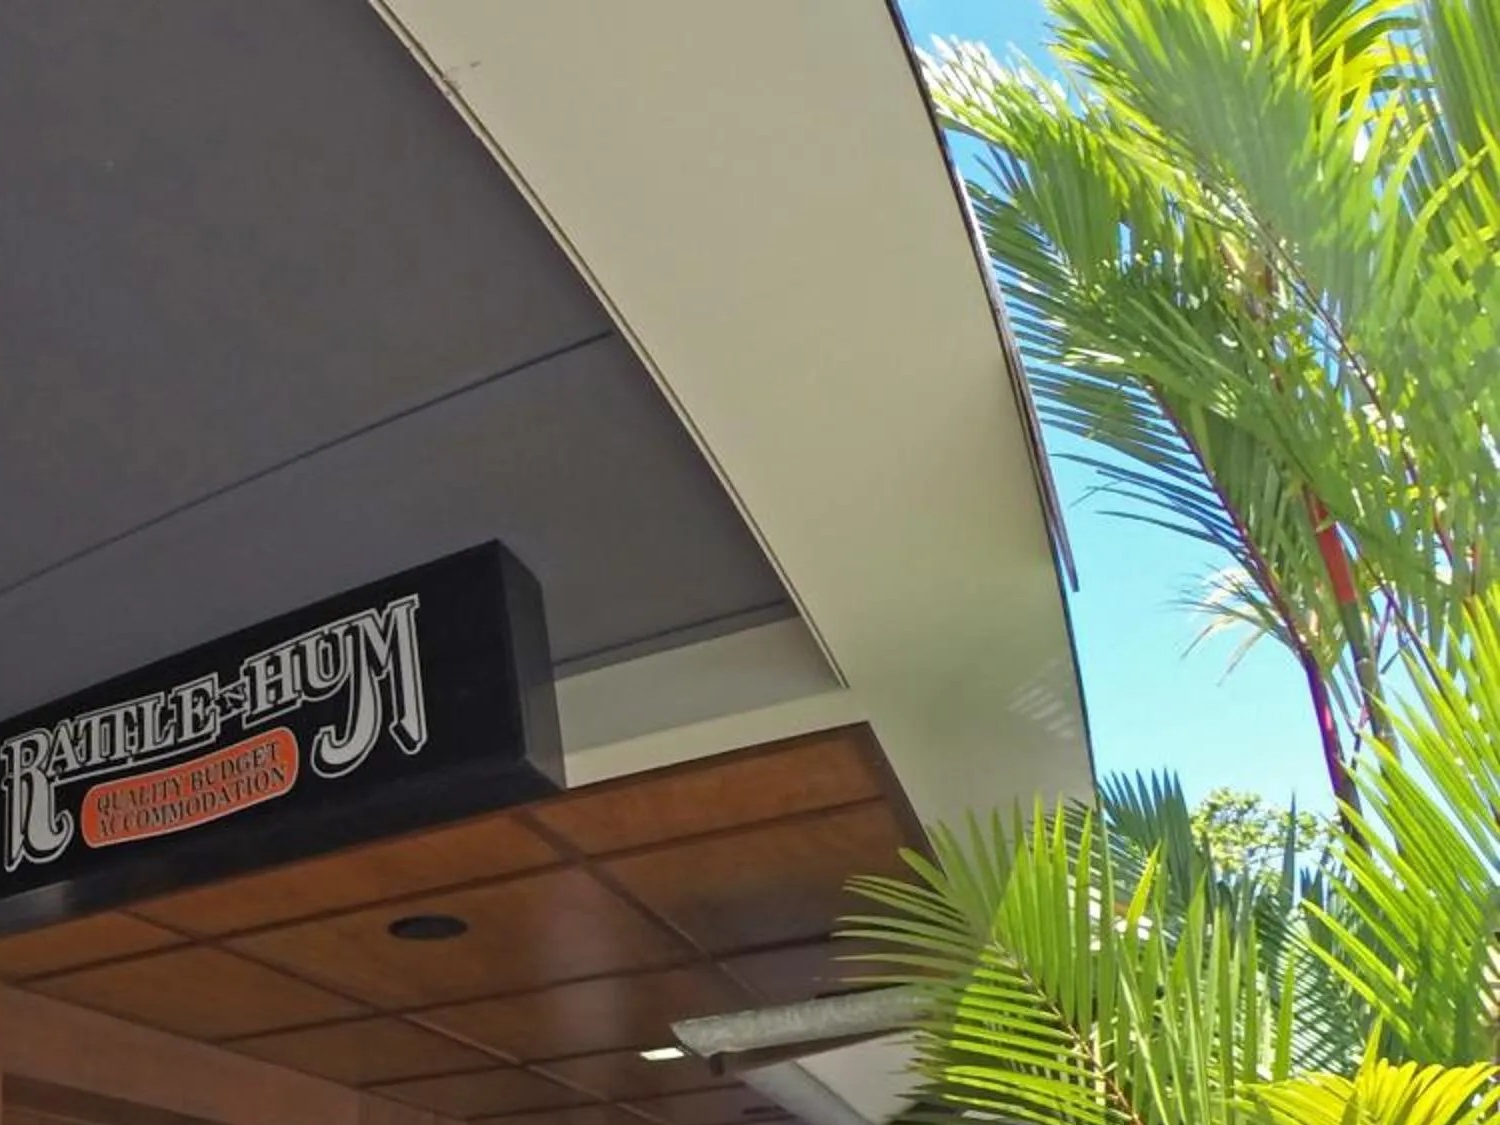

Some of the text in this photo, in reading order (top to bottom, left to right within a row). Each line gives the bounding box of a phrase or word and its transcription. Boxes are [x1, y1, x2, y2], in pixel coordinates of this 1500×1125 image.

[1, 671, 220, 872] RATTLE
[240, 593, 428, 779] HUM
[96, 739, 280, 815] QUALITY BUDGET
[98, 765, 287, 838] ACCOMMODATION
